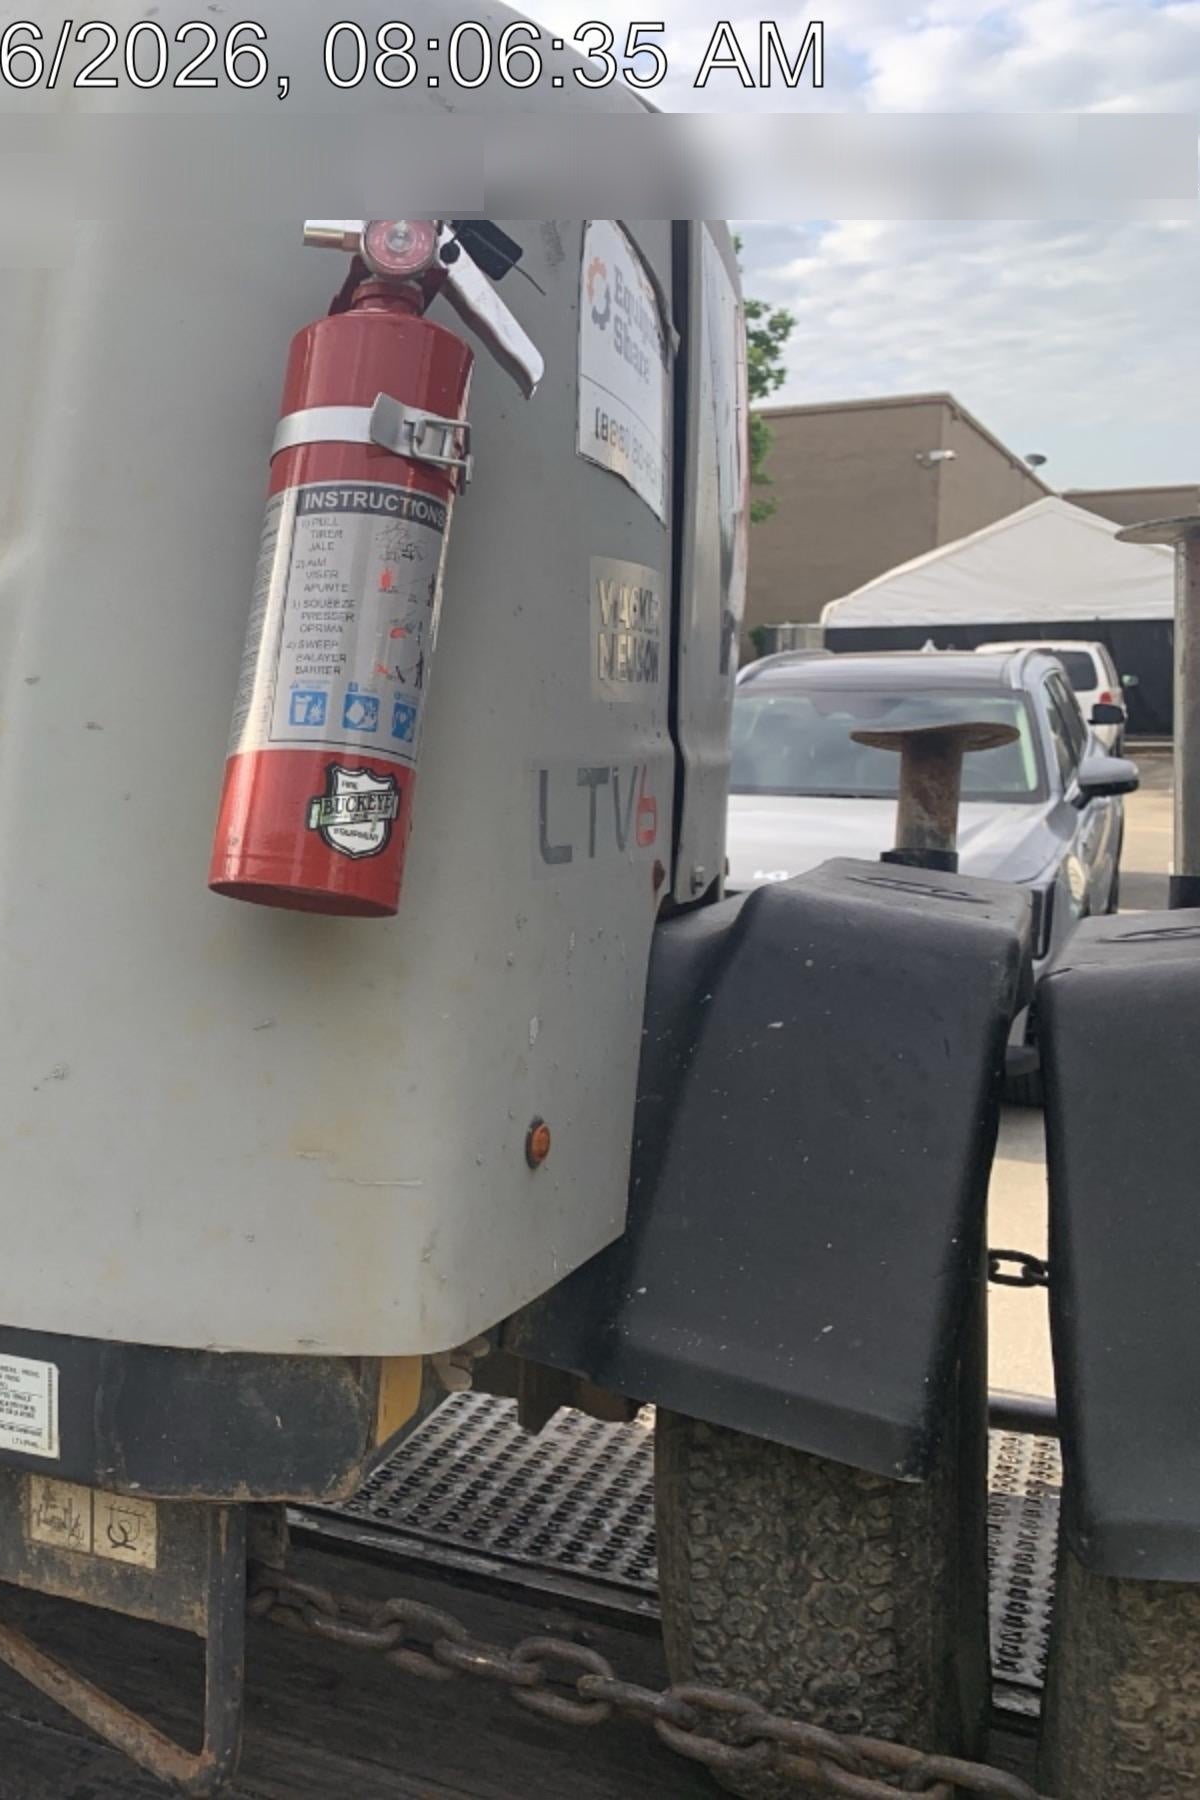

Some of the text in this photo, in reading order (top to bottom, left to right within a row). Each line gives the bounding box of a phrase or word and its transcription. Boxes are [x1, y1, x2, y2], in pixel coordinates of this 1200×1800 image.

[303, 491, 447, 528] INSTRUCTIONS
[323, 793, 392, 816] BUCKEYE
[539, 764, 658, 865] LTV6
